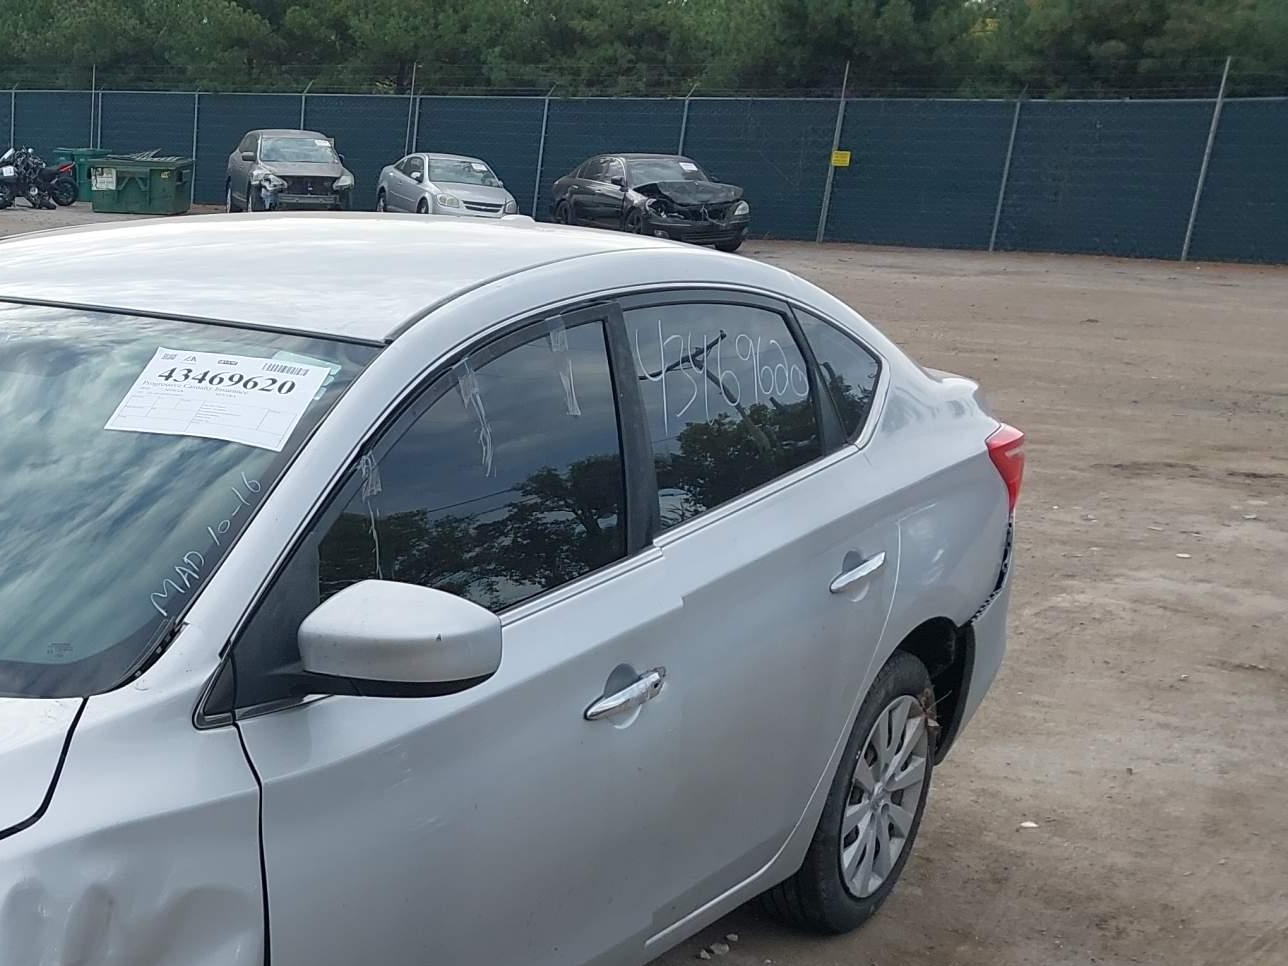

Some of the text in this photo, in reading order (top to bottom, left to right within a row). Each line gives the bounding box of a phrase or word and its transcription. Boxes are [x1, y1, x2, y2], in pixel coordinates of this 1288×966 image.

[158, 367, 296, 394] 43469620
[150, 551, 205, 616] MAD
[207, 471, 261, 546] 10-16
